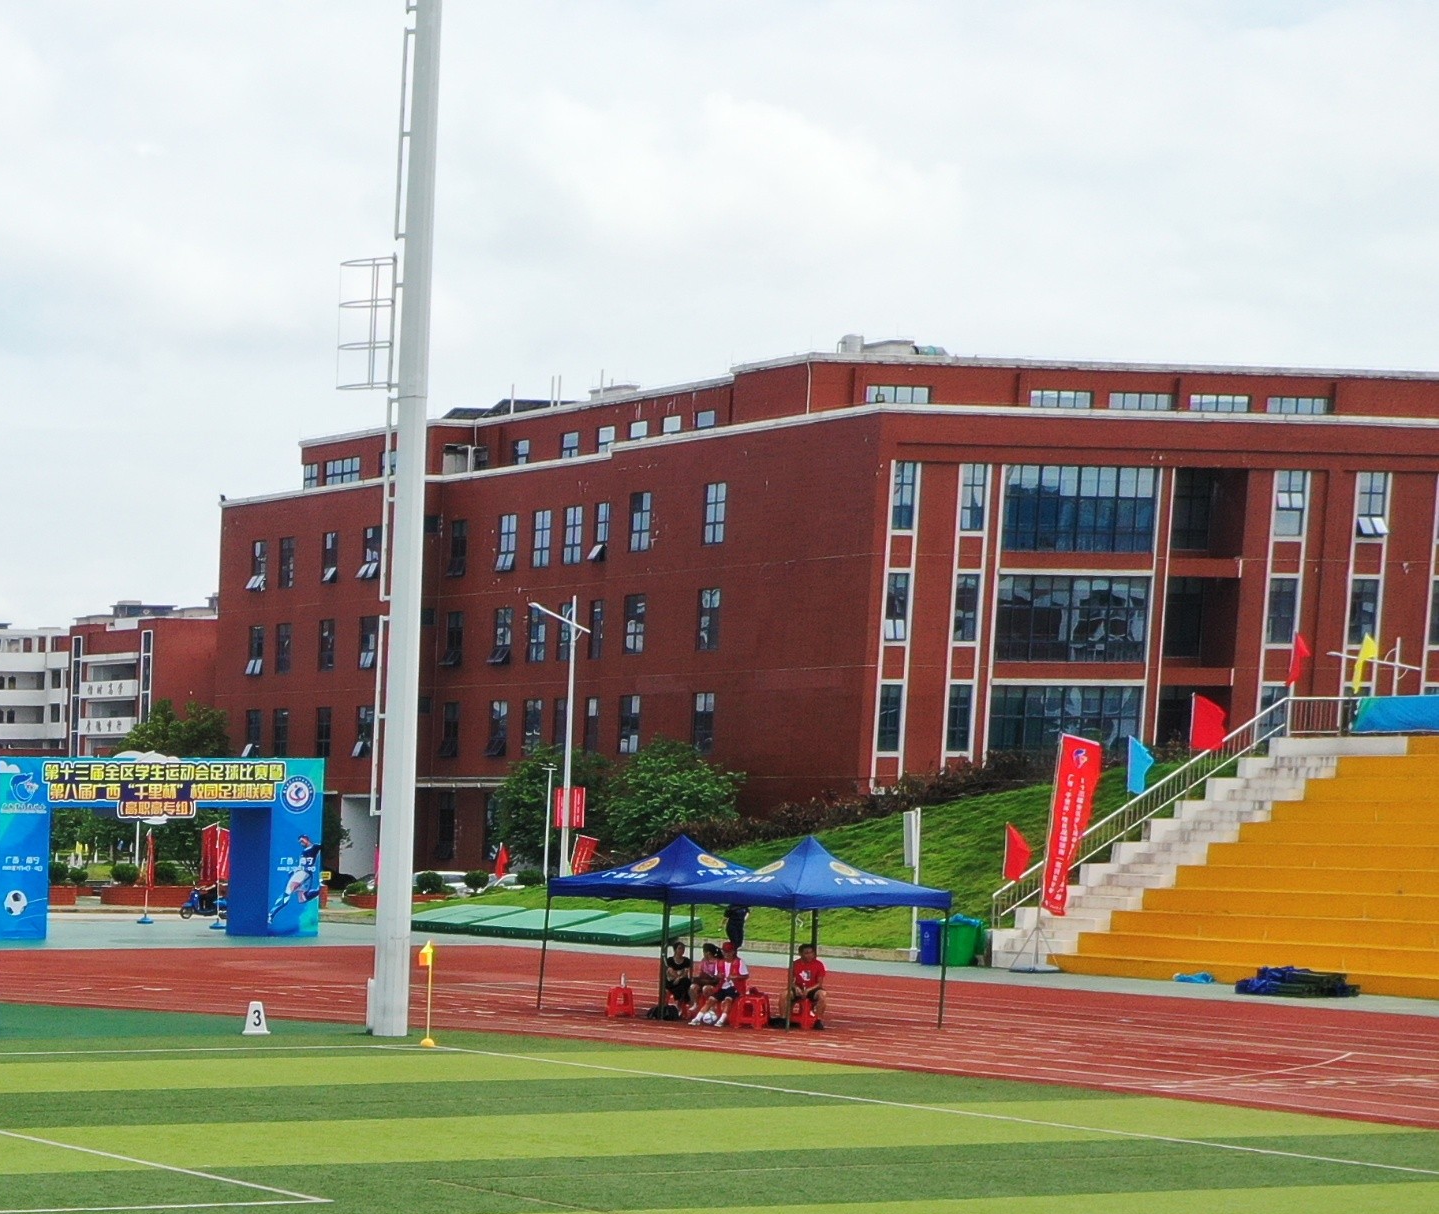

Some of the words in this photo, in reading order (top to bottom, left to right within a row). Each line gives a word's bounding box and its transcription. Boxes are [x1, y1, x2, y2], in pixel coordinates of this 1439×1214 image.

[44, 763, 285, 782] 第十三届全区学生运动会足球比赛暨
[253, 1010, 262, 1026] 3
